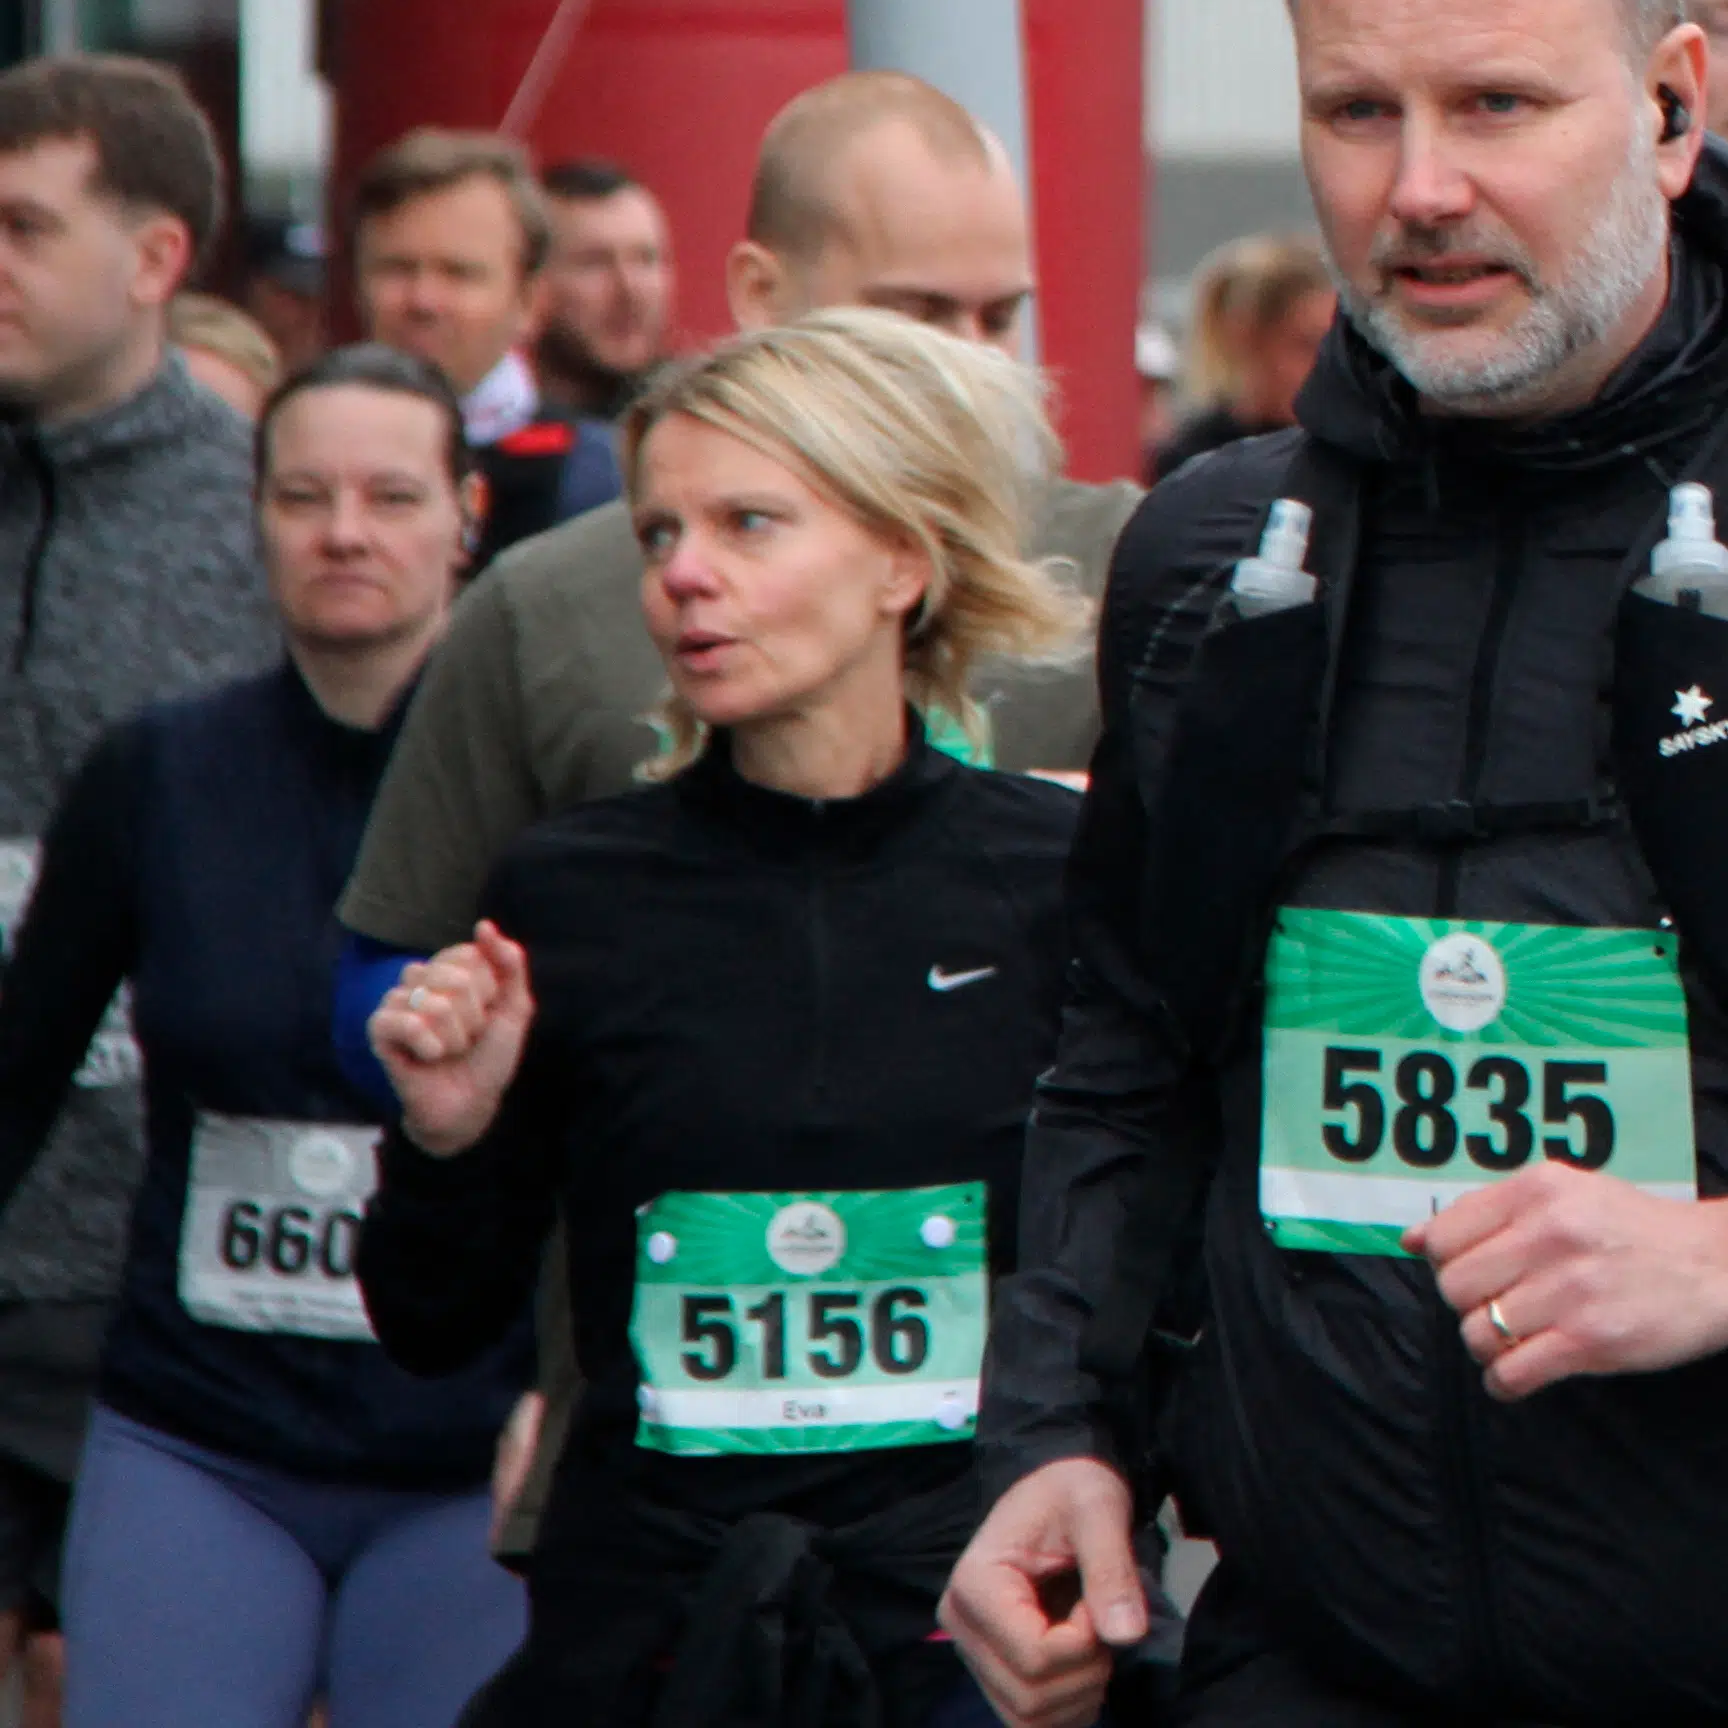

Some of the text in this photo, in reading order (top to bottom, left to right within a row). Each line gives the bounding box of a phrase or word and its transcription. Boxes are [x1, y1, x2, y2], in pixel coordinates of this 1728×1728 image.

[1322, 1045, 1615, 1172] 5835
[221, 1202, 362, 1278] 660
[681, 1286, 929, 1381] 5156
[783, 1400, 826, 1419] Eva
